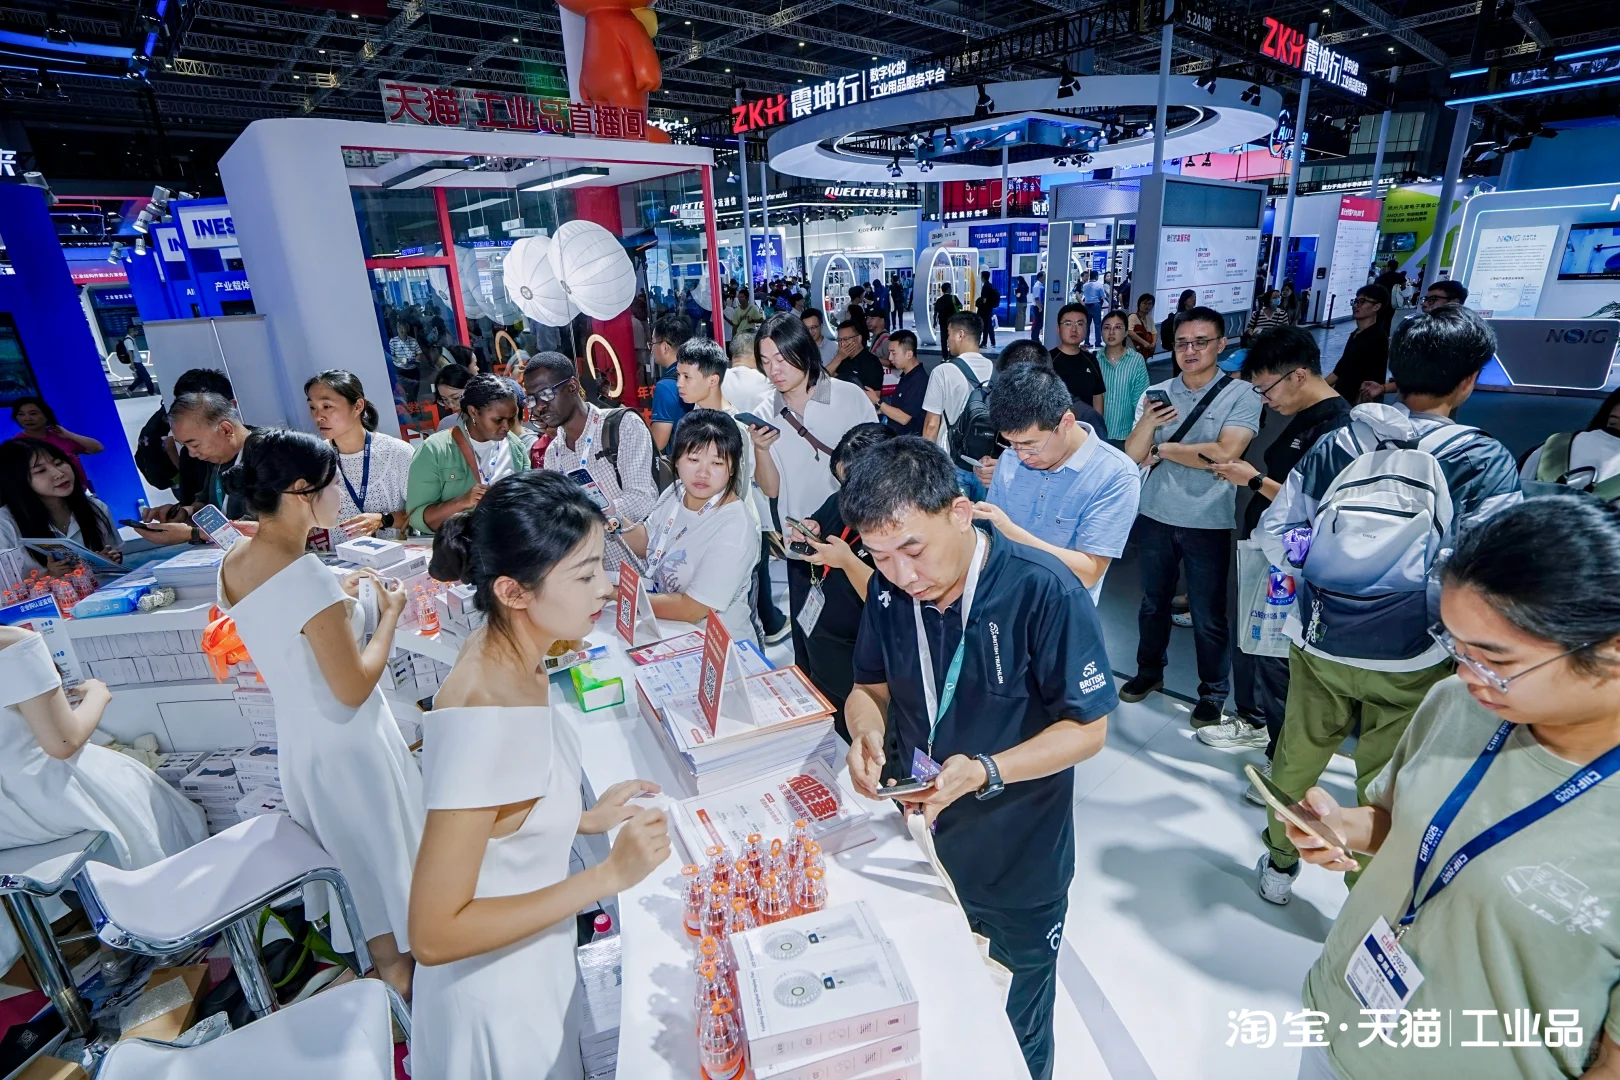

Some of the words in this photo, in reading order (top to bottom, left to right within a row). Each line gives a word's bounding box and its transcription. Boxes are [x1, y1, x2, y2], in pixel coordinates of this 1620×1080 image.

[1186, 9, 1212, 32] 5.2A188
[1262, 16, 1306, 69] ZKH
[869, 60, 907, 83] 数字化的
[1304, 38, 1341, 84] 震坤行
[870, 67, 946, 99] 工业用品服务平台
[790, 72, 861, 118] 震坤行
[384, 83, 461, 126] 天猫
[473, 92, 646, 140] 工业品直播间
[731, 93, 789, 135] ZKH
[824, 186, 881, 199] QUECTEL
[191, 217, 236, 237] INES
[994, 655, 1004, 684] TRIATHLON
[1079, 672, 1105, 690] BRITISH
[1081, 680, 1107, 695] TRIATHLON
[1577, 770, 1603, 790] CIIF
[1555, 784, 1581, 803] 2025
[1424, 824, 1440, 845] 2025
[1419, 841, 1430, 863] CIIF
[1453, 853, 1469, 870] CIIF
[1381, 934, 1396, 953] CIIF
[1393, 953, 1408, 974] 2025
